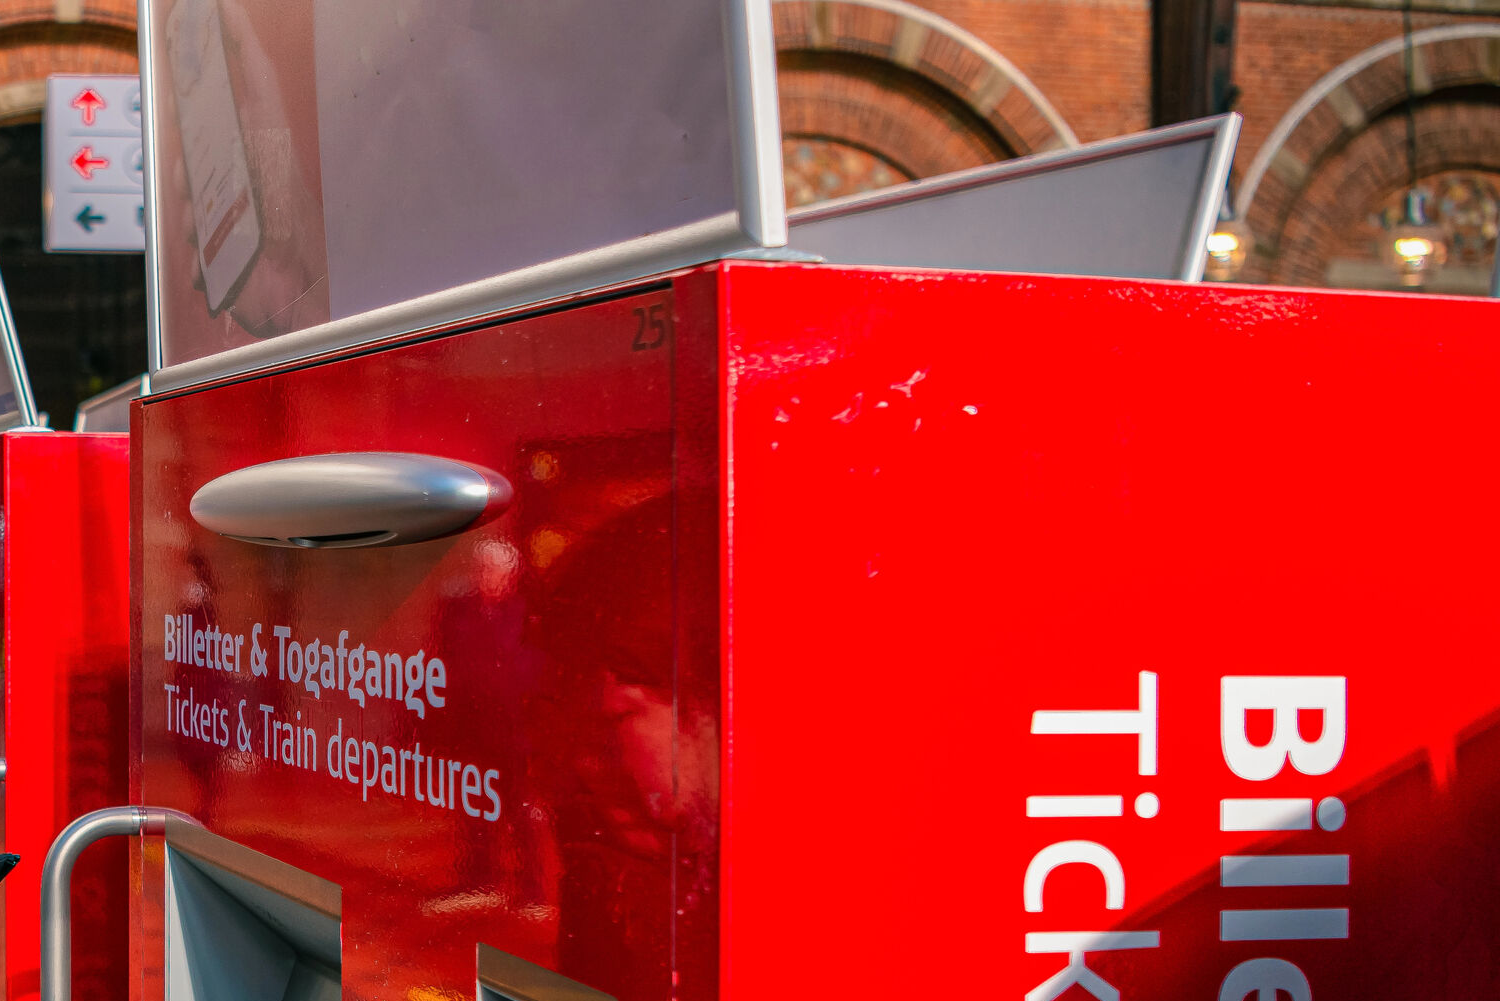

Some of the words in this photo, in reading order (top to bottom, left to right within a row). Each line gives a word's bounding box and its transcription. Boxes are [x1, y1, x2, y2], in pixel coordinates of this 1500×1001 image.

[631, 303, 667, 352] 25
[163, 613, 244, 673] Billetter
[250, 622, 268, 679] &
[273, 625, 447, 720] Togafgange
[163, 683, 229, 748] Tickets
[236, 698, 253, 752] &
[259, 702, 318, 773] Train
[326, 717, 501, 823] departures
